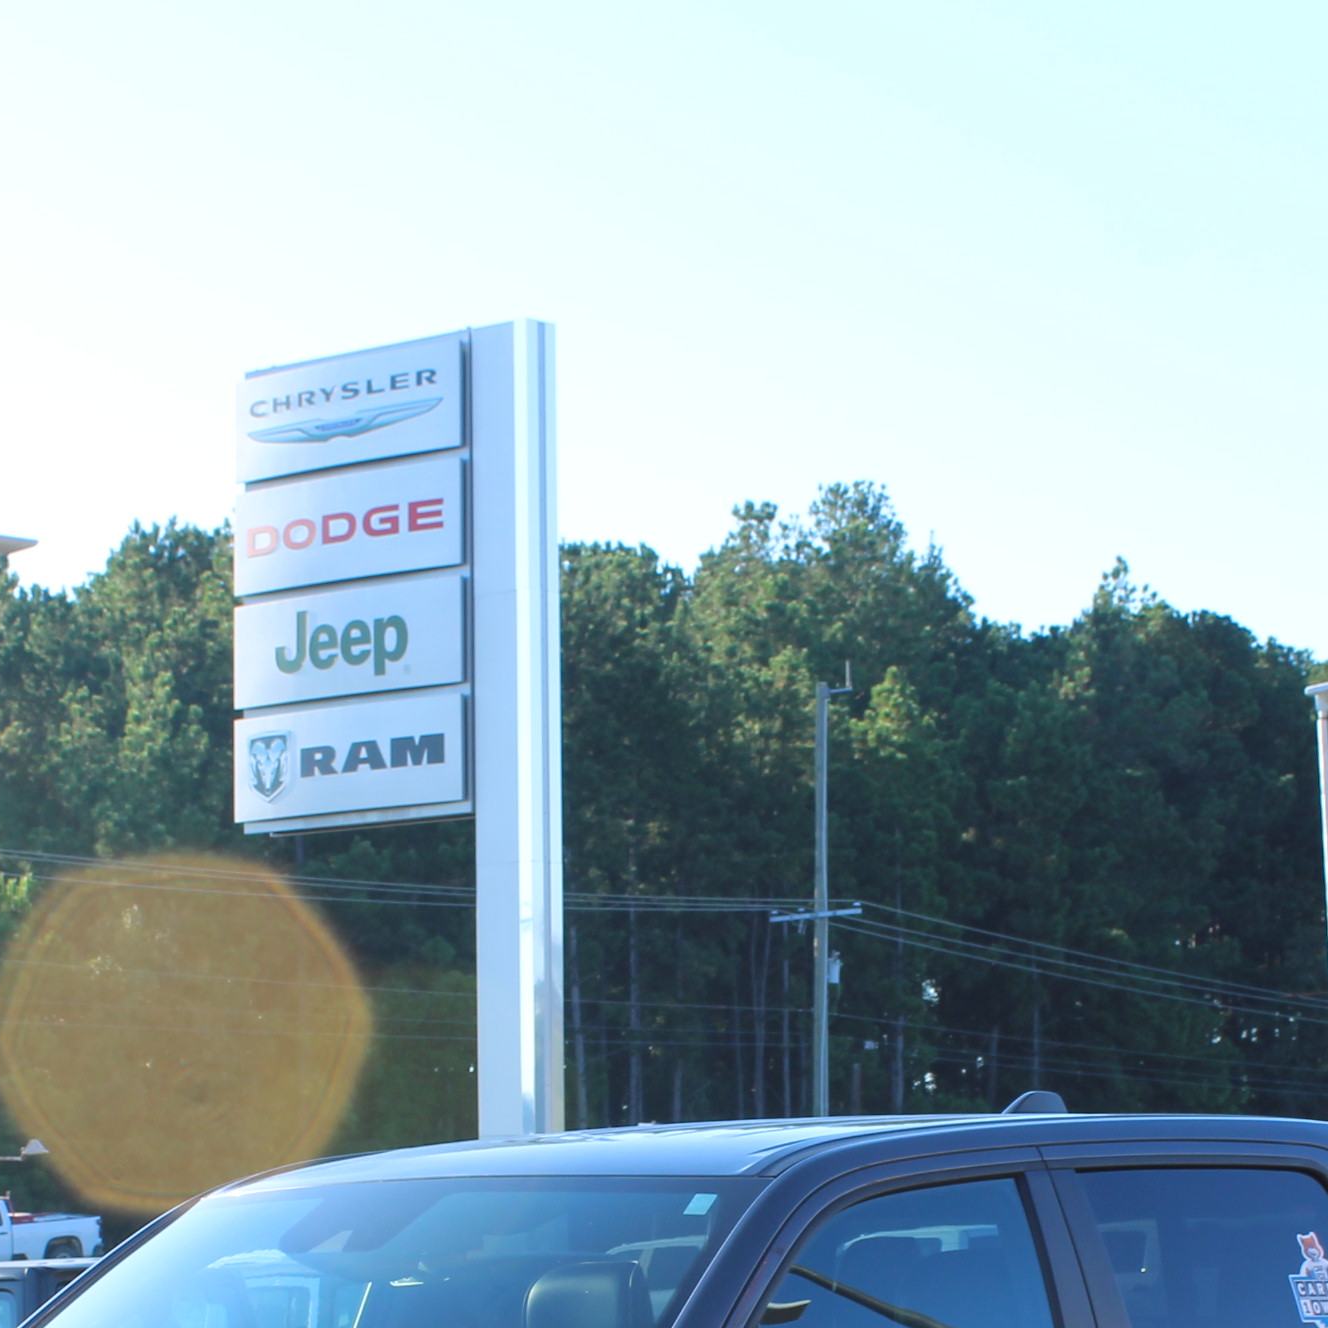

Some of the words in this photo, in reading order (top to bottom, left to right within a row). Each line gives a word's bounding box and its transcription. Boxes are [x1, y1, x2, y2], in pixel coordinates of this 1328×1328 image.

[249, 367, 438, 419] CHRYSLER
[246, 497, 445, 559] DODGE
[275, 610, 409, 676] Jeep
[300, 733, 446, 778] RAM
